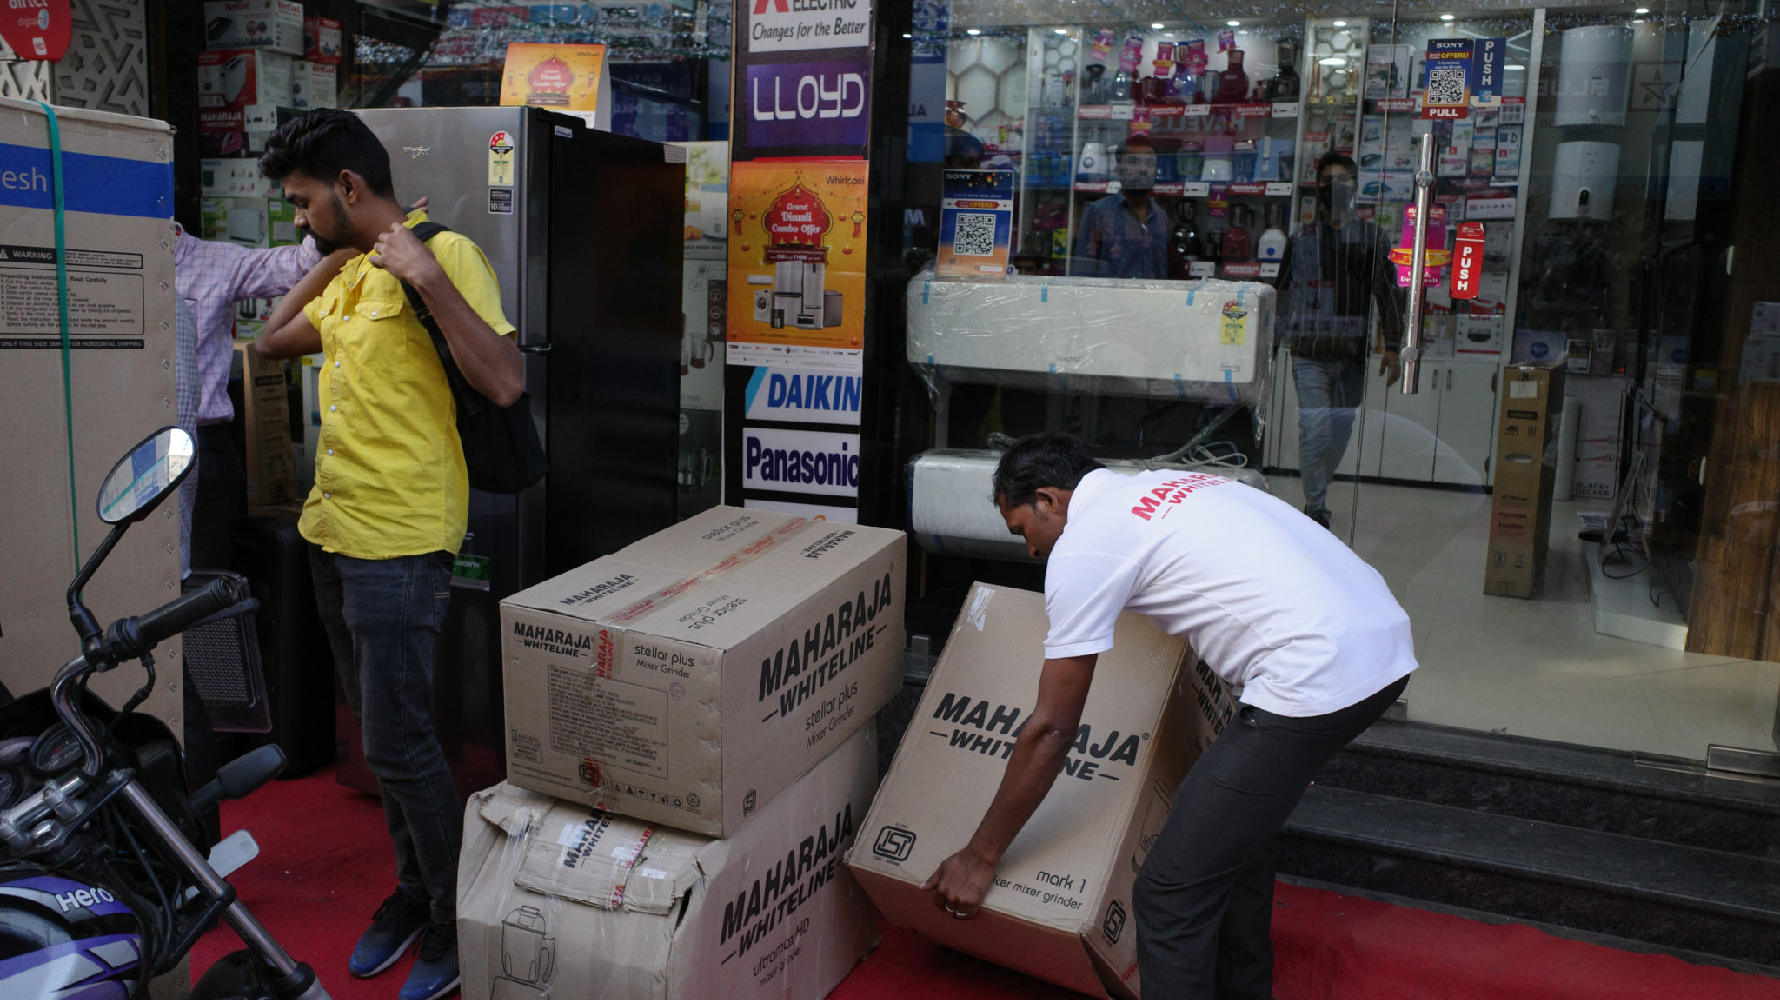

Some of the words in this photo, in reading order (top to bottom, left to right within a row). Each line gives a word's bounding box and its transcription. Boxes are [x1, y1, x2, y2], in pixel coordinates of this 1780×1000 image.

[753, 23, 795, 41] Changes
[797, 21, 812, 39] for
[814, 21, 831, 37] the
[834, 17, 867, 36] Better
[1482, 41, 1495, 86] PUSH
[753, 72, 865, 121] LLOYD
[1429, 108, 1459, 117] PULL
[0, 166, 47, 192] esh
[826, 175, 865, 188] Whirlpool
[780, 211, 813, 223] Diwali
[787, 203, 808, 211] Grand
[772, 224, 799, 233] Combo
[800, 224, 822, 236] Offer
[13, 250, 53, 260] WARNING
[1457, 246, 1473, 292] PUSH
[767, 373, 861, 412] DAIKIN
[746, 436, 860, 488] Panasonic
[560, 573, 634, 606] MAHARAJA
[514, 622, 592, 652] MAHARAJA
[523, 638, 579, 658] WHITELINE
[759, 572, 892, 702] MAHARAJA
[634, 644, 669, 663] stellar
[671, 653, 695, 670] plus
[636, 658, 658, 672] Mixer
[659, 665, 691, 680] Grinder
[780, 625, 876, 718] WHITELINE
[805, 697, 837, 732] stellar
[838, 682, 859, 715] plus
[806, 724, 827, 749] Mixer
[828, 704, 855, 733] Grinder
[720, 803, 853, 947] MAHARAJA
[1036, 871, 1073, 890] mark
[1080, 878, 1087, 894] 1
[56, 887, 114, 913] Hero
[739, 856, 836, 959] WHITELINE
[1012, 883, 1042, 897] mixer
[1043, 893, 1083, 910] grinder
